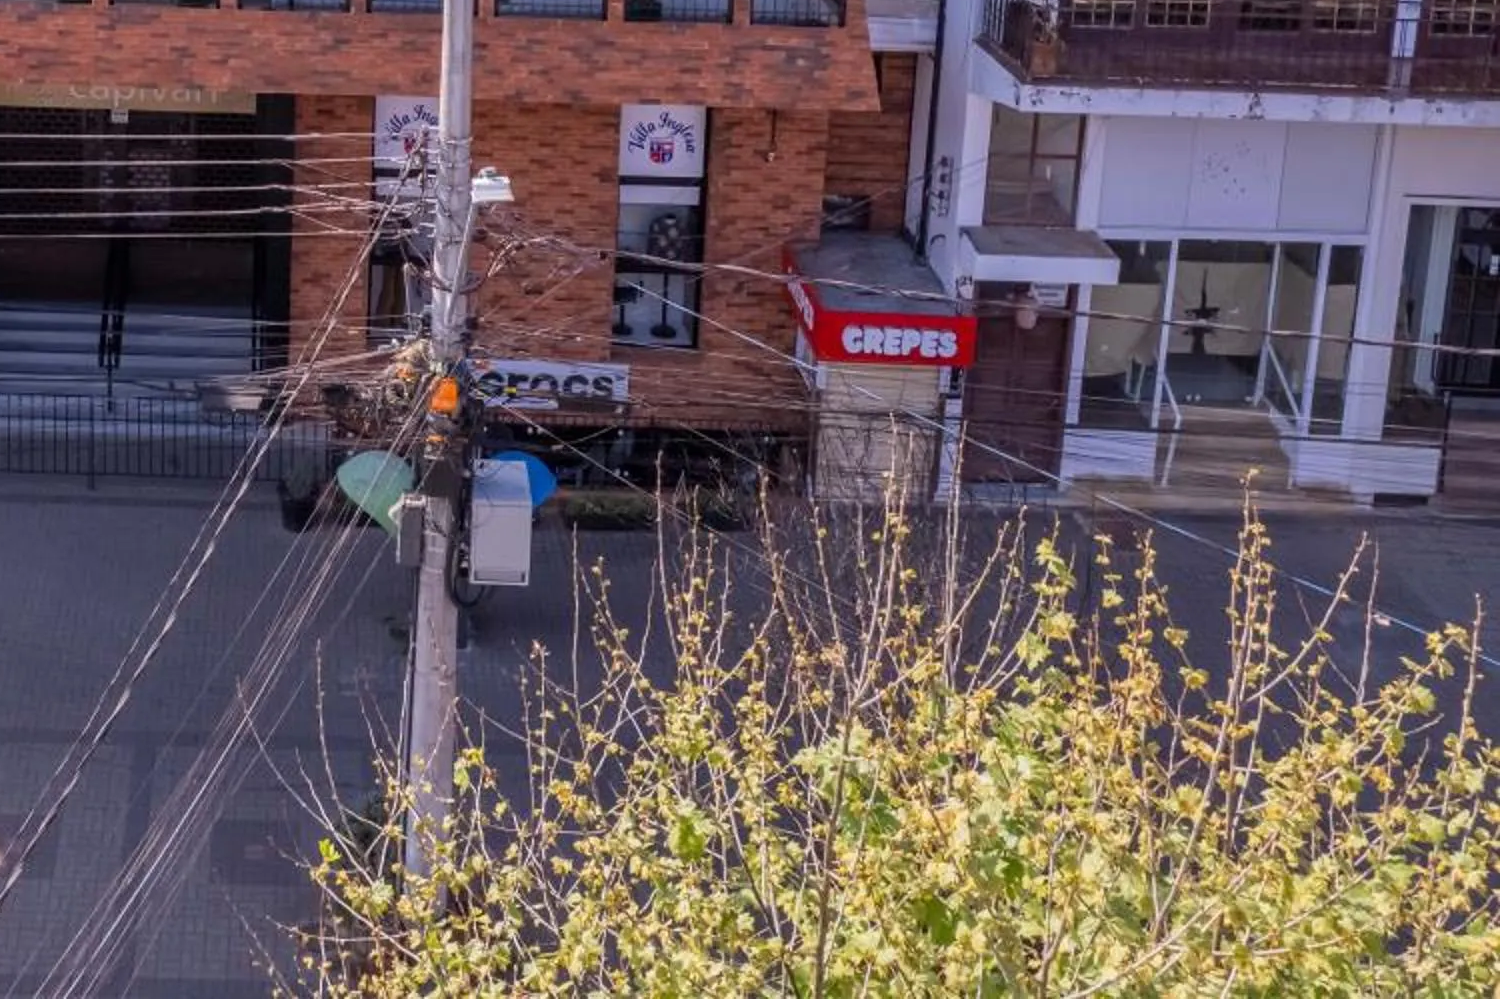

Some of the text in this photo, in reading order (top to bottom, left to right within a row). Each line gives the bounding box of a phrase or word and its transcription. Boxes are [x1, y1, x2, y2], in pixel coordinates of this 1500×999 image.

[627, 110, 696, 154] Villa Inglesa
[841, 325, 957, 358] CREPES
